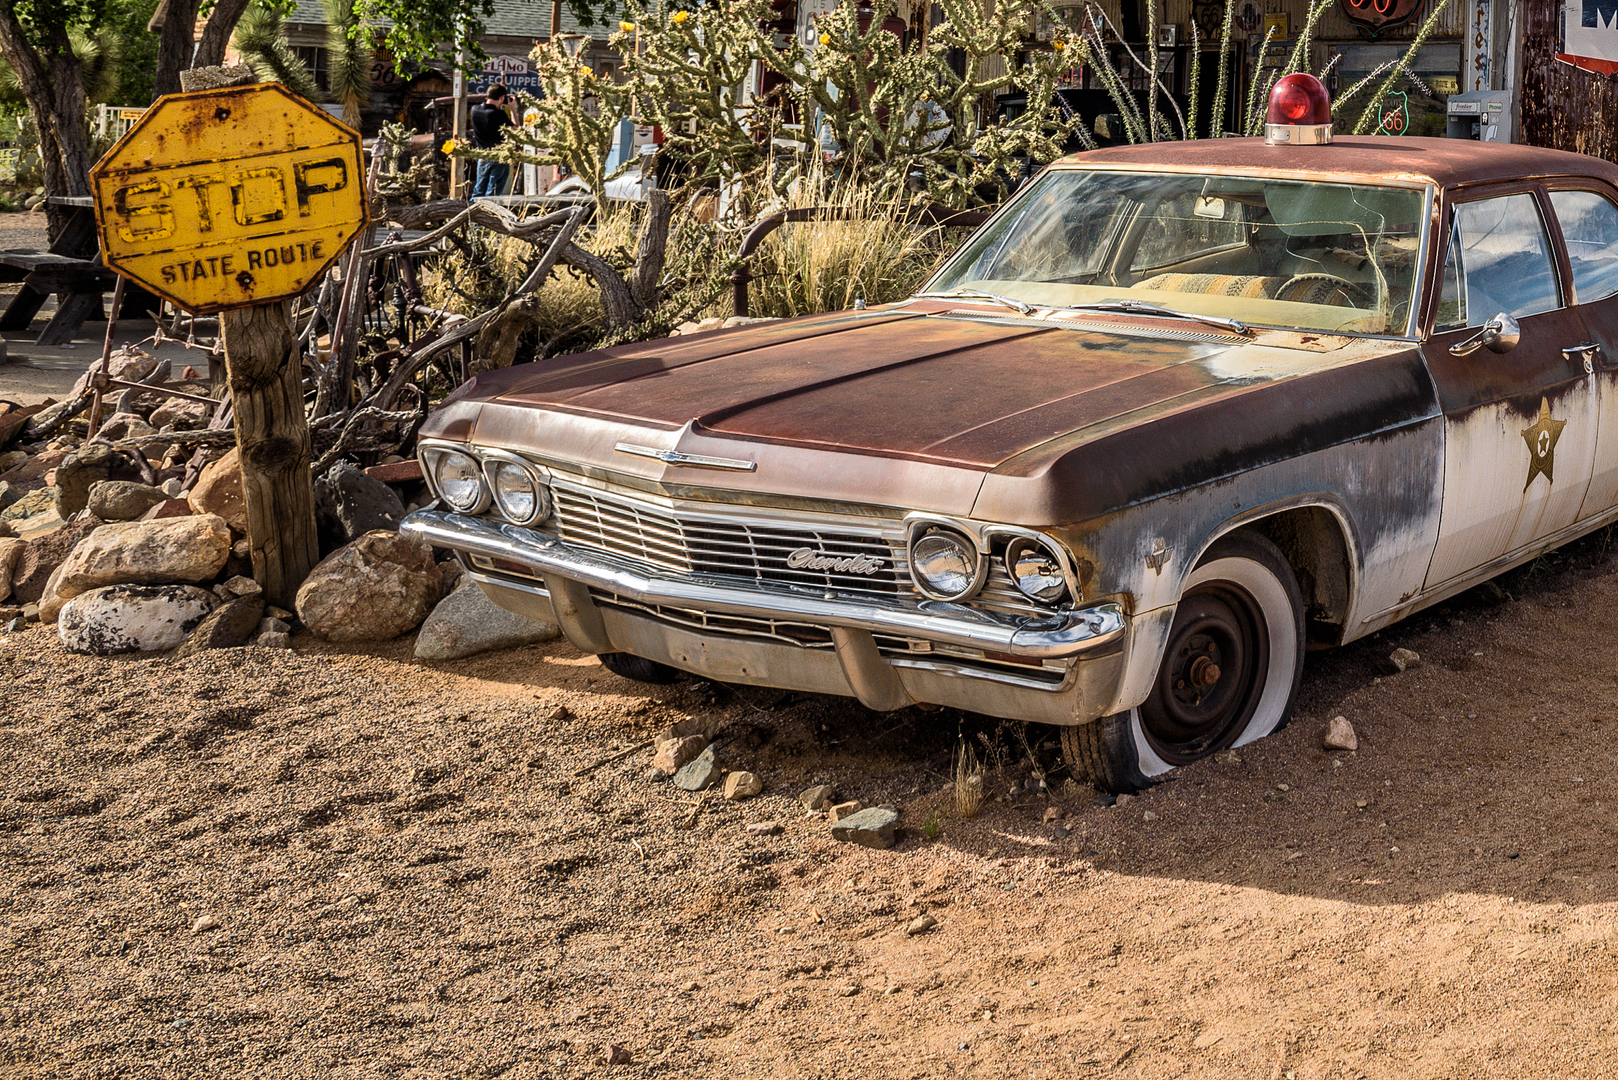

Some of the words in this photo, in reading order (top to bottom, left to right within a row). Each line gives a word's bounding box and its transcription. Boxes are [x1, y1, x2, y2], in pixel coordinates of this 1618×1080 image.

[813, 0, 826, 9] US
[1201, 7, 1219, 26] 66
[1384, 111, 1403, 131] 66
[113, 157, 348, 243] STOP
[161, 255, 236, 285] STATE
[247, 240, 325, 271] ROUTE
[787, 547, 885, 575] Chevrolet
